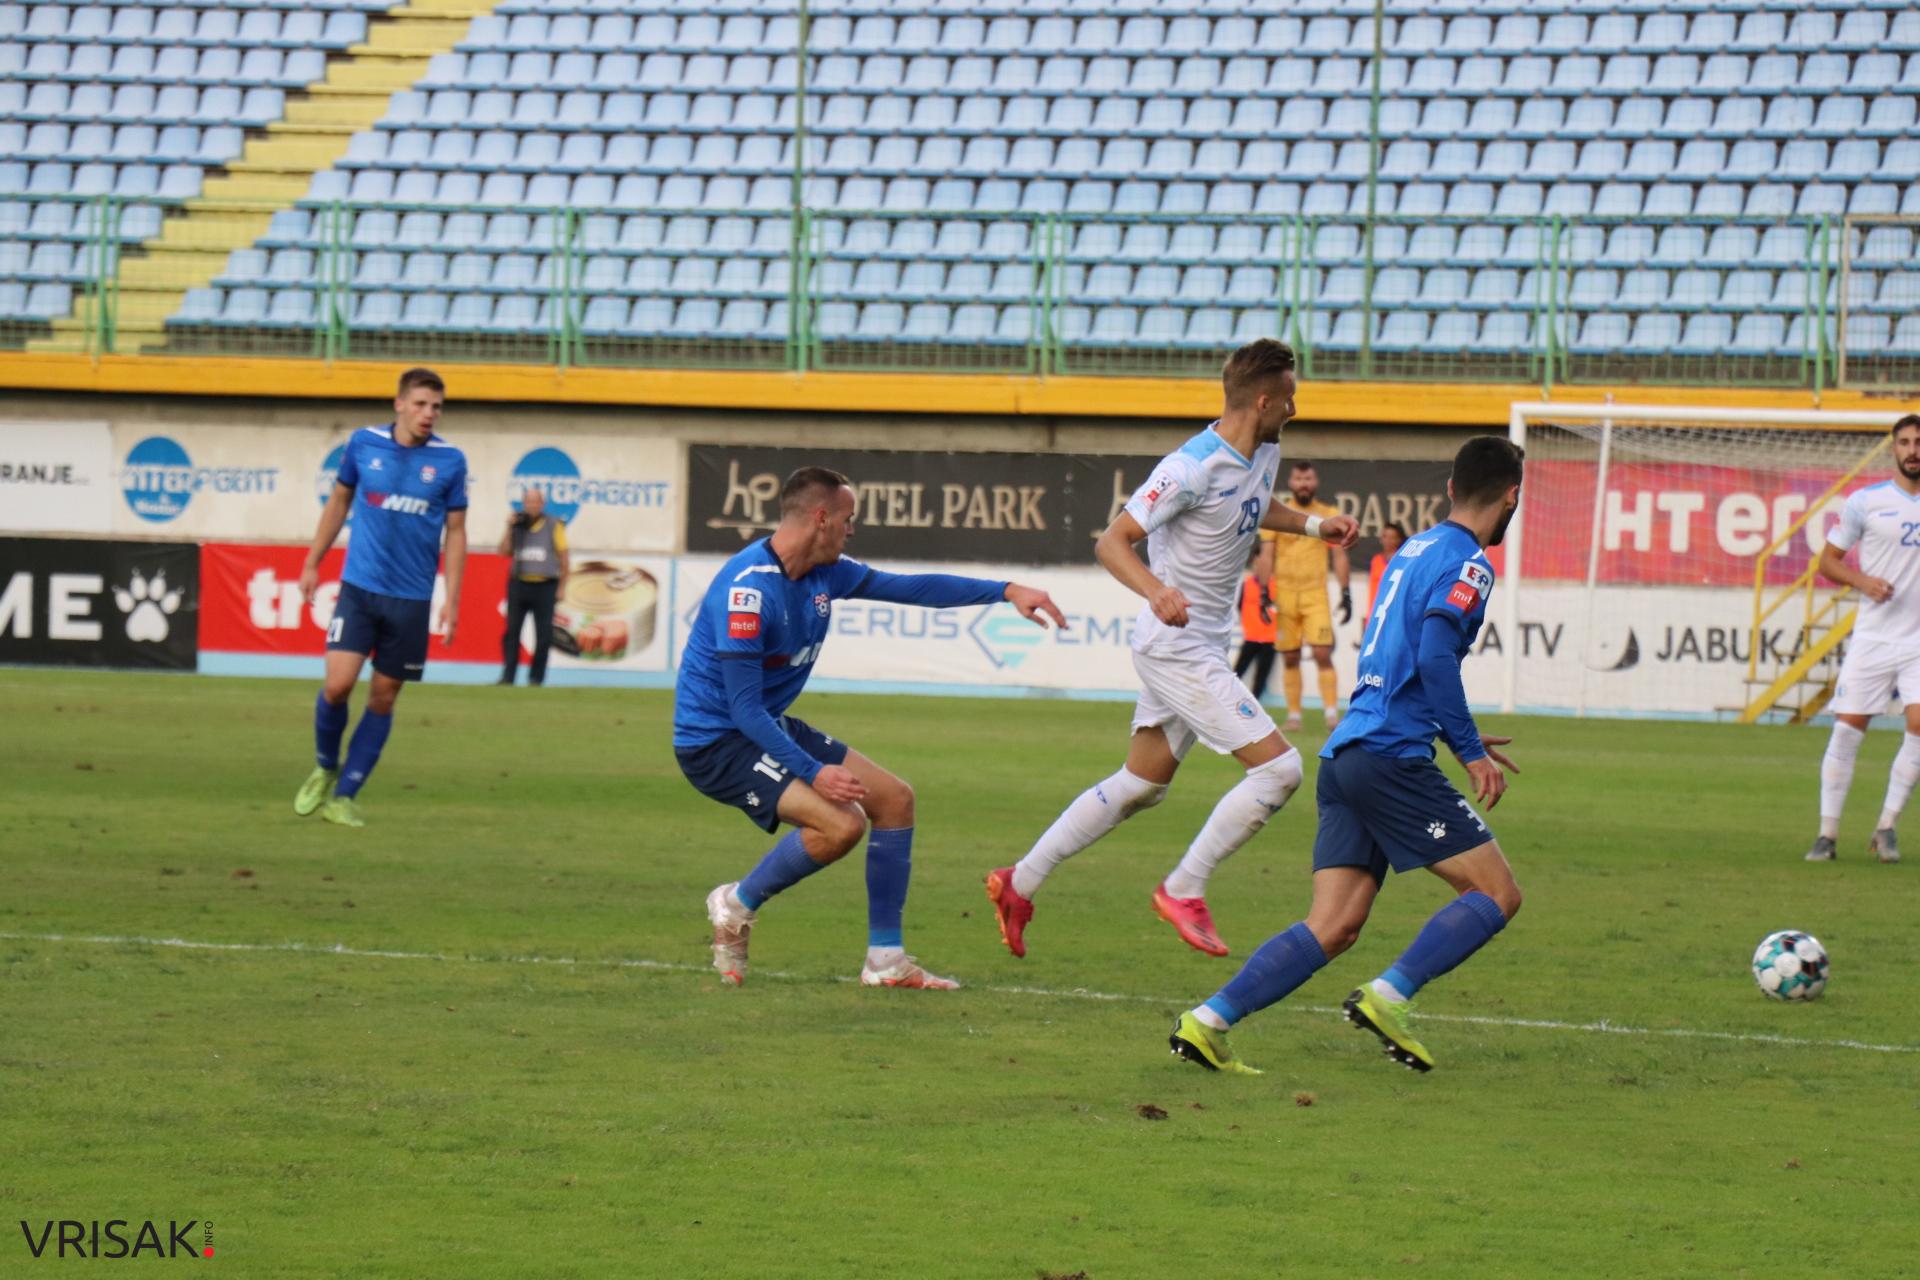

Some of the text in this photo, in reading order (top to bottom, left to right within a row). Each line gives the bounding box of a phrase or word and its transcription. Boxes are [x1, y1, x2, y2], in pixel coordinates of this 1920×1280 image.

[941, 483, 1047, 530] PARK
[1237, 496, 1260, 537] 29
[1335, 493, 1442, 536] PARK
[1604, 491, 1704, 553] HT
[838, 607, 958, 640] ERUS
[1516, 622, 1564, 657] TV
